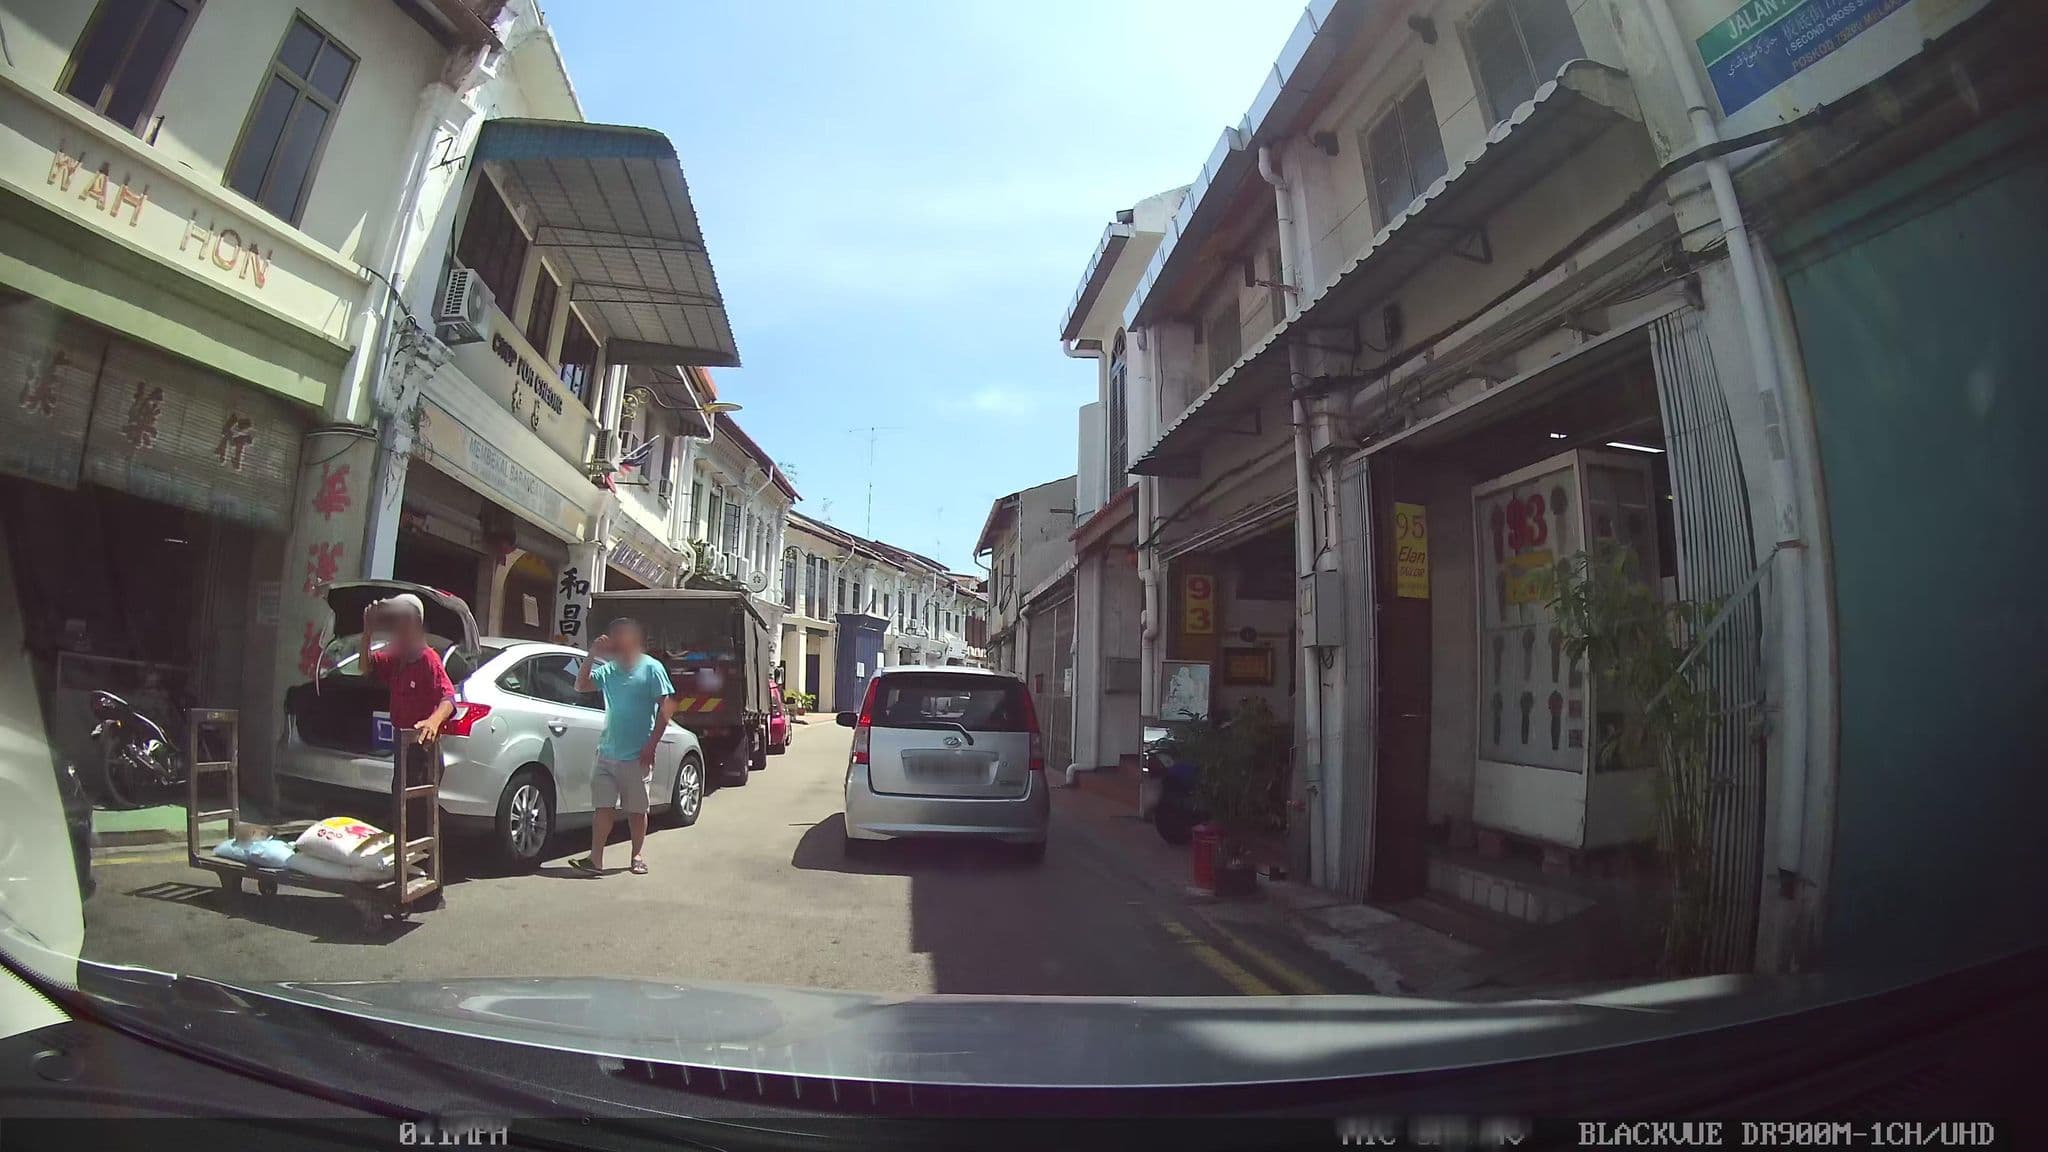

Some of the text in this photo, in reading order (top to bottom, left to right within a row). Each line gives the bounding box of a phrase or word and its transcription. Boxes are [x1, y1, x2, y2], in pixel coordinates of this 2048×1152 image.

[1729, 0, 1778, 39] JALAN
[1826, 2, 1856, 27] CROSS
[47, 148, 273, 289] WAH HON
[1396, 512, 1425, 539] 95
[1399, 545, 1426, 564] Elan
